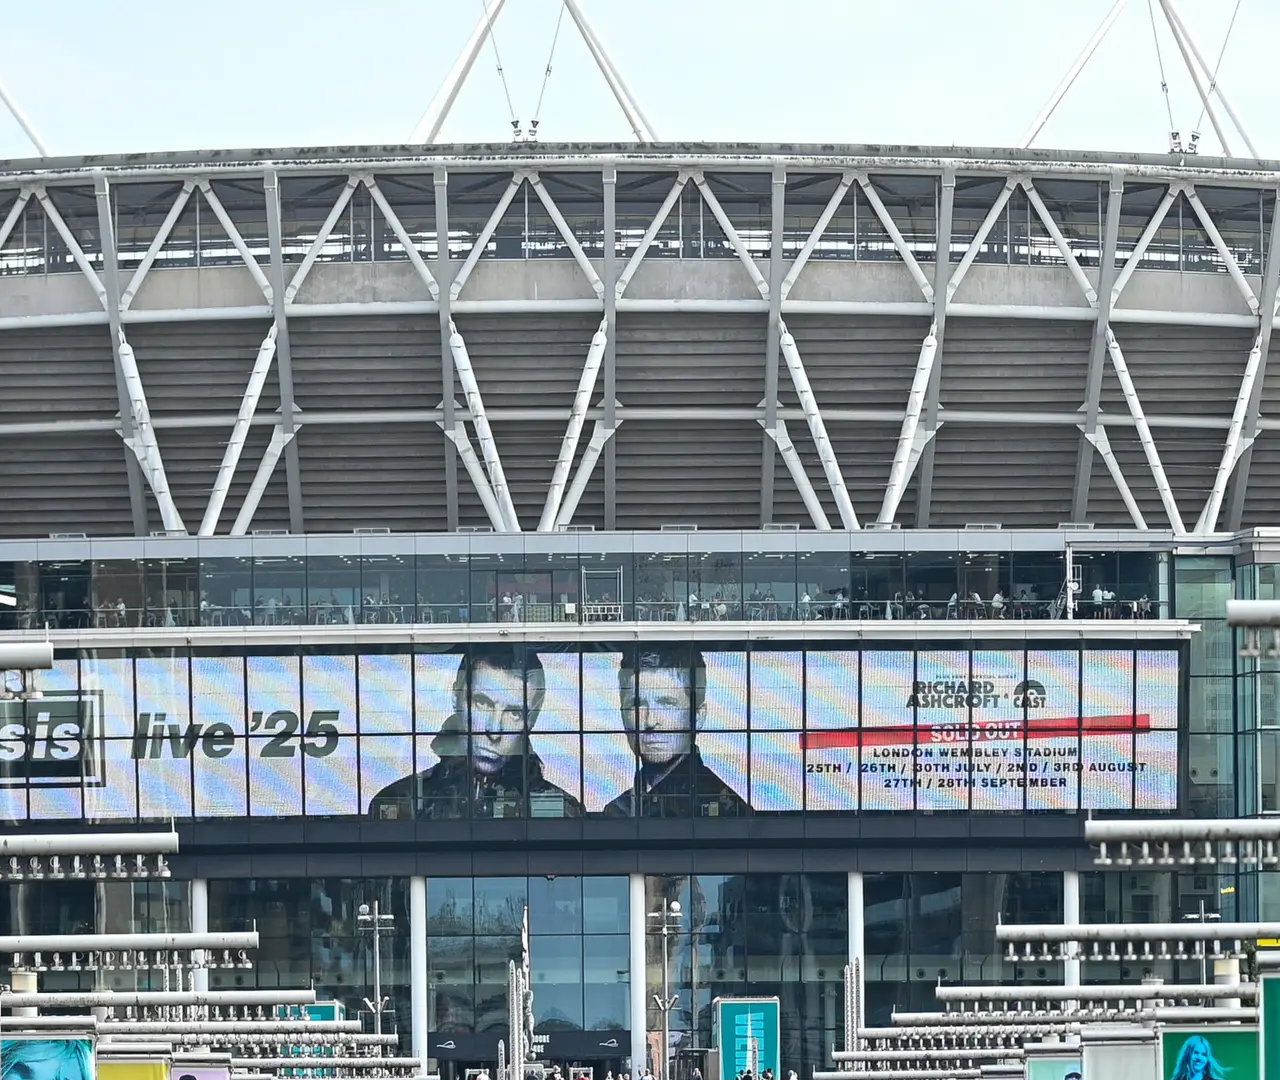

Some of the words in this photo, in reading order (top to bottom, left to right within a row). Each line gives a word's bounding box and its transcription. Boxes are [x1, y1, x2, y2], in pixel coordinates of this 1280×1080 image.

[915, 681, 994, 694] RICHARD
[907, 695, 1000, 708] ASHCROFT
[1013, 697, 1046, 708] CAST
[131, 712, 235, 759] live
[250, 710, 340, 758] '25
[931, 725, 980, 742] SOLD
[985, 722, 1020, 740] OUT
[873, 748, 933, 758] LONDON
[939, 748, 1008, 758] WEMBLEY
[1014, 748, 1077, 758] STADIUM
[807, 763, 842, 773] 25TH
[860, 763, 897, 773] 26TH
[916, 763, 950, 773] 30TH
[955, 763, 990, 773] JULY
[1007, 763, 1038, 773] 2ND
[1054, 763, 1083, 773] 3RD
[1089, 763, 1147, 773] AUGUST
[884, 778, 922, 788] 27TH
[938, 778, 977, 788] 28TH
[981, 778, 1067, 788] SEPTEMBER
